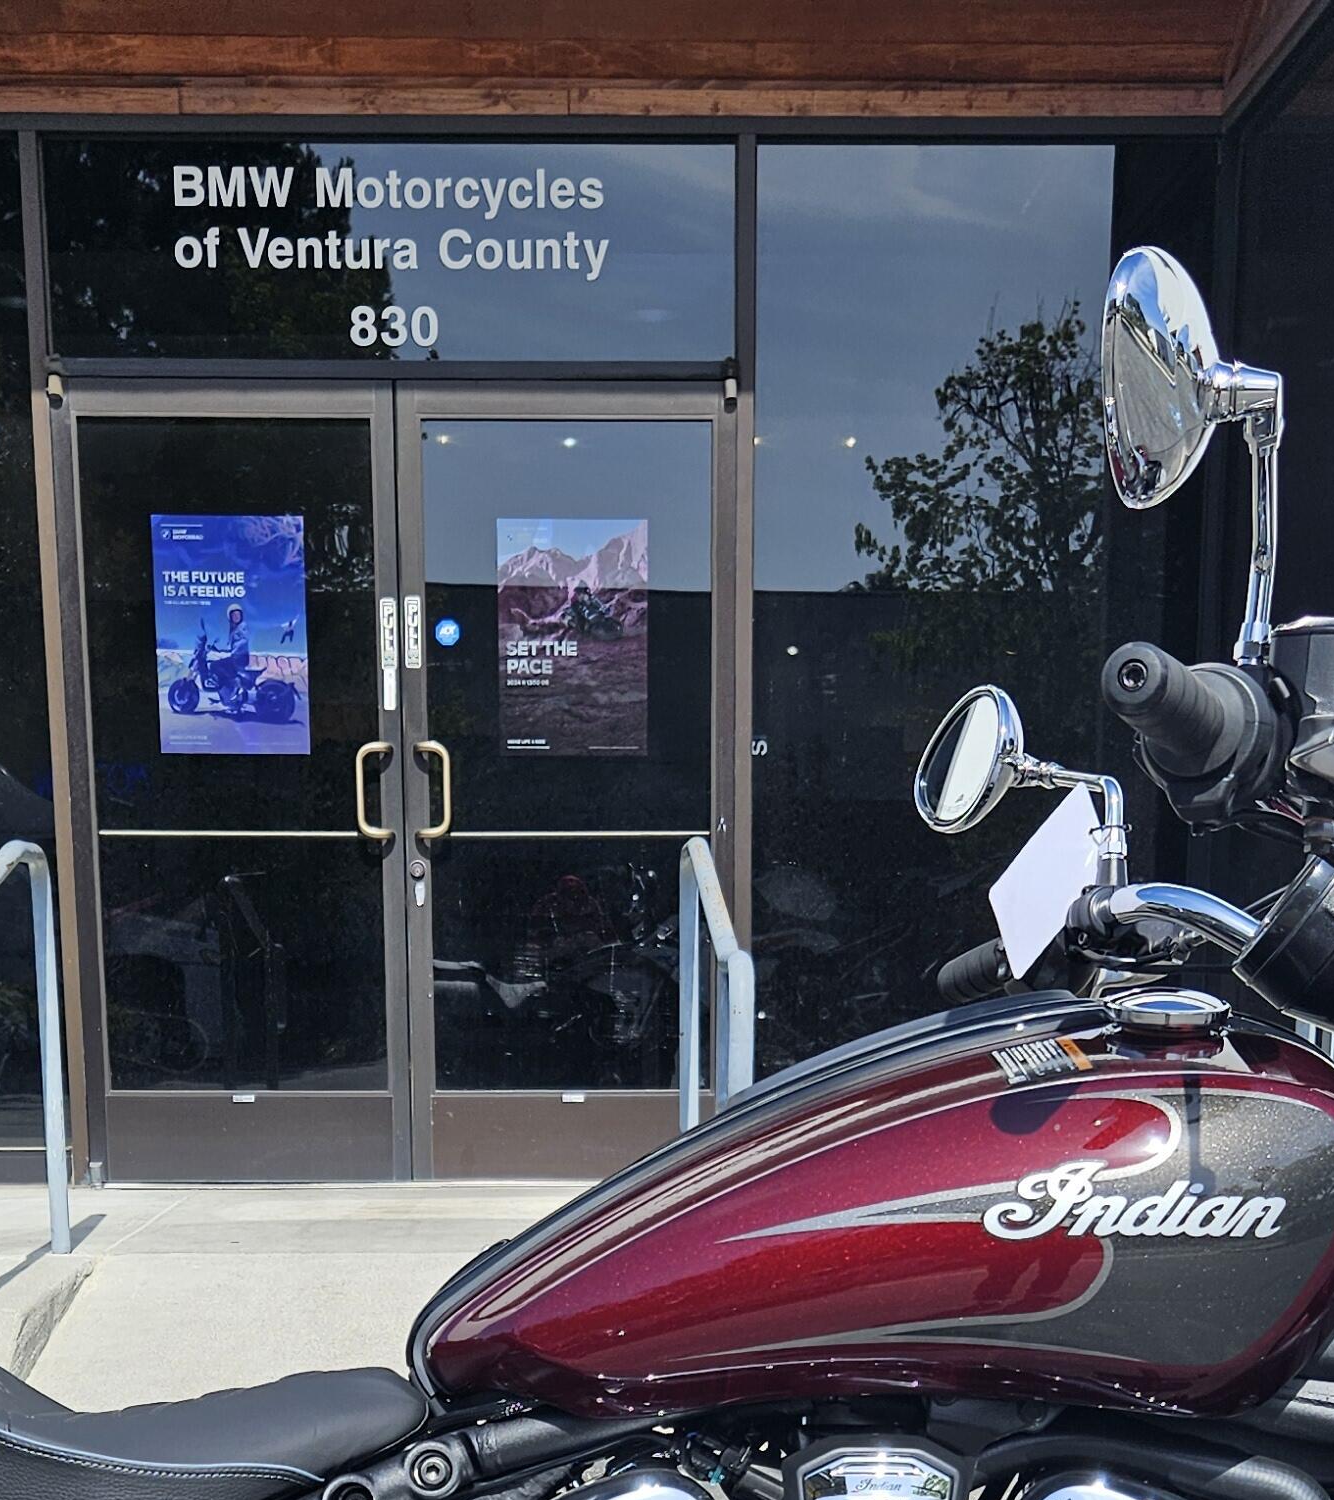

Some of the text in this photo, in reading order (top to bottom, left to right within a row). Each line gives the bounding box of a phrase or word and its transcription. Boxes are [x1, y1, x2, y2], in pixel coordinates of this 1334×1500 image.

[173, 165, 605, 221] BMW Motorcycles
[173, 227, 609, 281] of Ventura County
[349, 305, 439, 347] 830
[162, 571, 245, 584] THE FUTURE
[163, 585, 246, 598] IS A FEELING
[383, 605, 395, 651] PULL
[408, 603, 419, 650] PULL
[506, 641, 578, 656] SET THE
[506, 660, 554, 674] PACE
[983, 1159, 1287, 1240] Indian
[854, 1477, 902, 1491] Indian
